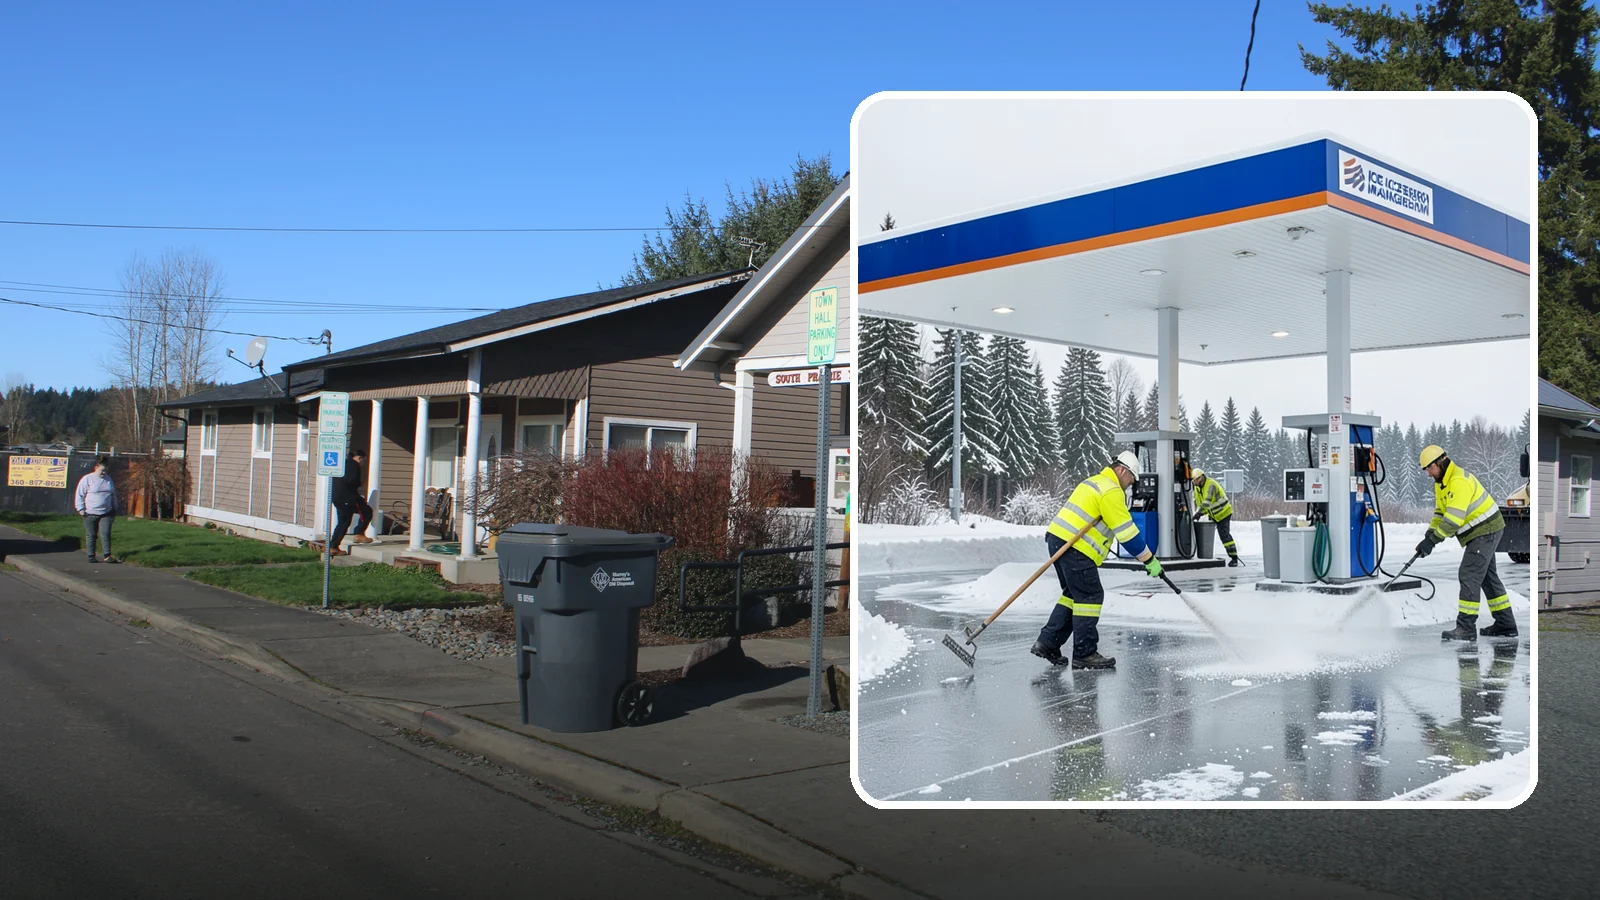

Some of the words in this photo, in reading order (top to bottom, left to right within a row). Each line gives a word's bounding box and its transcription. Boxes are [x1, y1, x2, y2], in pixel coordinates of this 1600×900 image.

[815, 294, 833, 308] TOWN
[814, 311, 831, 324] HALL
[810, 326, 836, 340] PARKING
[813, 344, 831, 357] ONLY
[775, 373, 801, 384] SOUTH
[808, 370, 842, 383] PRIE
